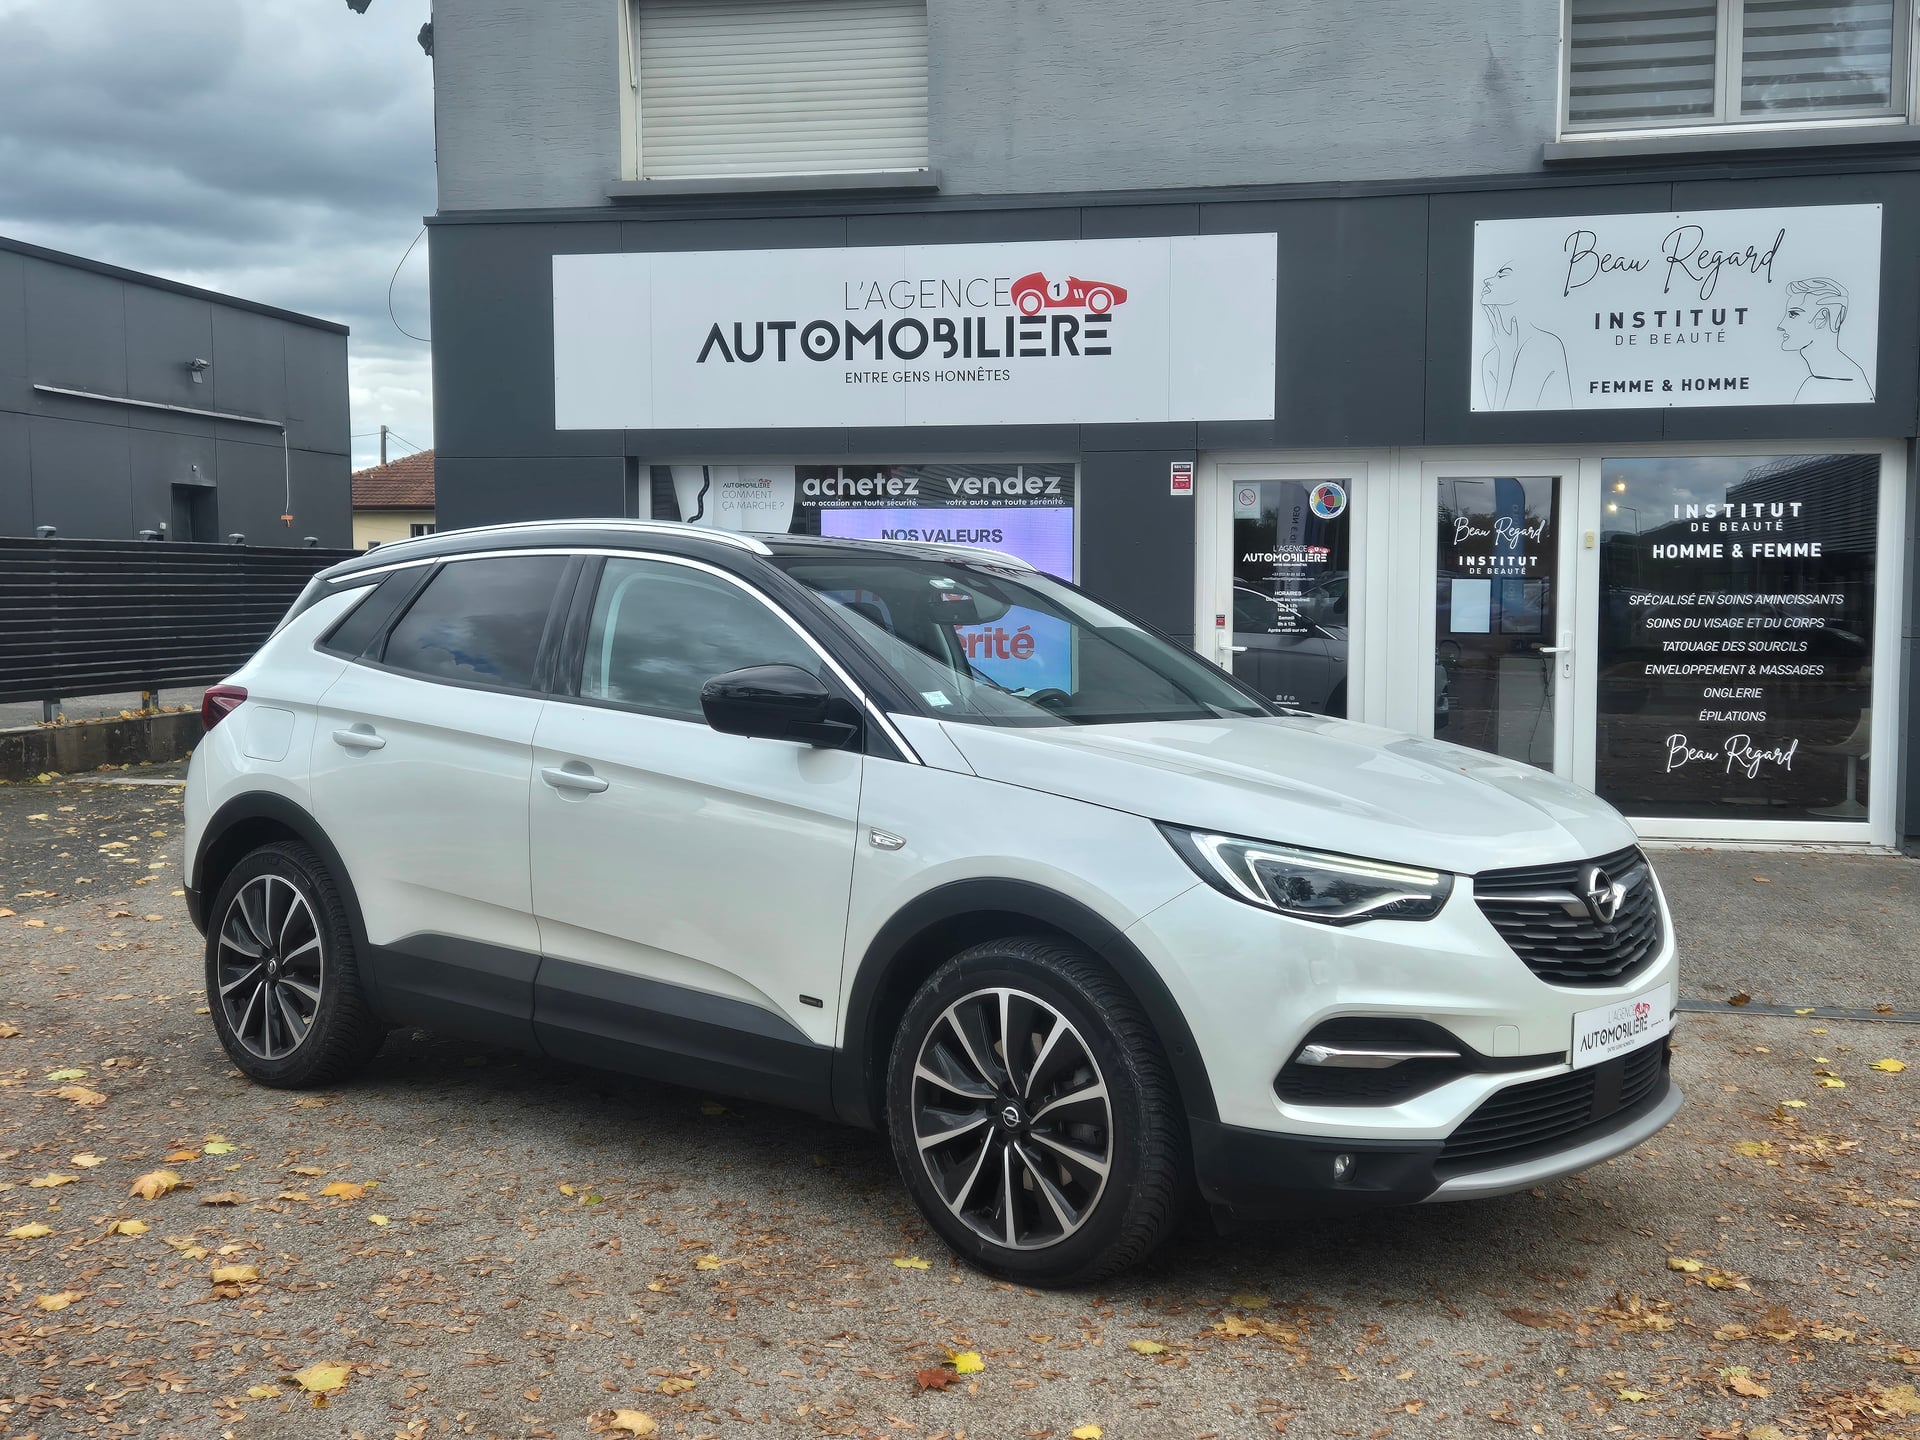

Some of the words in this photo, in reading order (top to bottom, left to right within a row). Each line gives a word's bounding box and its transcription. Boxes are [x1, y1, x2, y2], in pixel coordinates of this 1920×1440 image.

[1562, 229, 1650, 298] Beau
[1661, 224, 1786, 300] Regard
[844, 277, 1011, 311] L'AGENCE
[1594, 306, 1749, 330] INSTITUT
[1615, 334, 1637, 346] DE
[1650, 330, 1726, 346] BEAUTÉ
[845, 371, 888, 384] ENTRE
[892, 370, 930, 384] GENS
[934, 366, 1010, 383] HONNÊTES
[1589, 379, 1654, 394] FEMME
[1662, 378, 1673, 393] &
[1681, 377, 1750, 392] HOMME
[802, 467, 920, 496] achetez
[946, 466, 1061, 495] vendez
[721, 490, 773, 499] COMMENT
[721, 501, 735, 511] ÇA
[736, 501, 777, 510] MARCHE
[780, 501, 785, 510] ?
[818, 499, 850, 507] occasion
[864, 499, 884, 507] toute
[945, 498, 967, 506] votre
[1673, 502, 1802, 518] INSTITUT
[1691, 522, 1710, 532] DE
[1719, 519, 1784, 532] BEAUTÉ
[881, 529, 919, 542] NOS
[921, 529, 1003, 544] VALEURS
[1453, 516, 1491, 546] Beau
[1494, 516, 1546, 550] Regard
[1652, 544, 1723, 559] HOMME
[1731, 543, 1744, 558] &
[1752, 542, 1822, 558] FEMME
[1458, 556, 1538, 567] INSTITUT
[1487, 566, 1527, 575] BEAUTÉ
[1628, 593, 1697, 606] SPÉCIALISÉ
[1697, 595, 1716, 605] EN
[1716, 595, 1754, 605] SOINS
[1753, 594, 1845, 605] AMINCISSANTS
[1646, 618, 1681, 629] SOINS
[1683, 618, 1701, 628] DU
[1703, 618, 1744, 628] VISAGE
[1747, 618, 1762, 628] ET
[1764, 618, 1781, 628] DU
[1783, 618, 1825, 628] CORPS
[1662, 641, 1720, 652] TATOUAGE
[1721, 641, 1746, 652] DES
[1747, 641, 1808, 652] SOURCILS
[1644, 665, 1747, 675] ENVELOPPEMENT
[1748, 665, 1757, 675] &
[1759, 665, 1825, 675] MASSAGES
[1703, 688, 1763, 698] ONGLERIE
[1699, 709, 1767, 722] ÉPILATIONS
[1666, 734, 1719, 773] Beau
[1724, 734, 1799, 779] Regard
